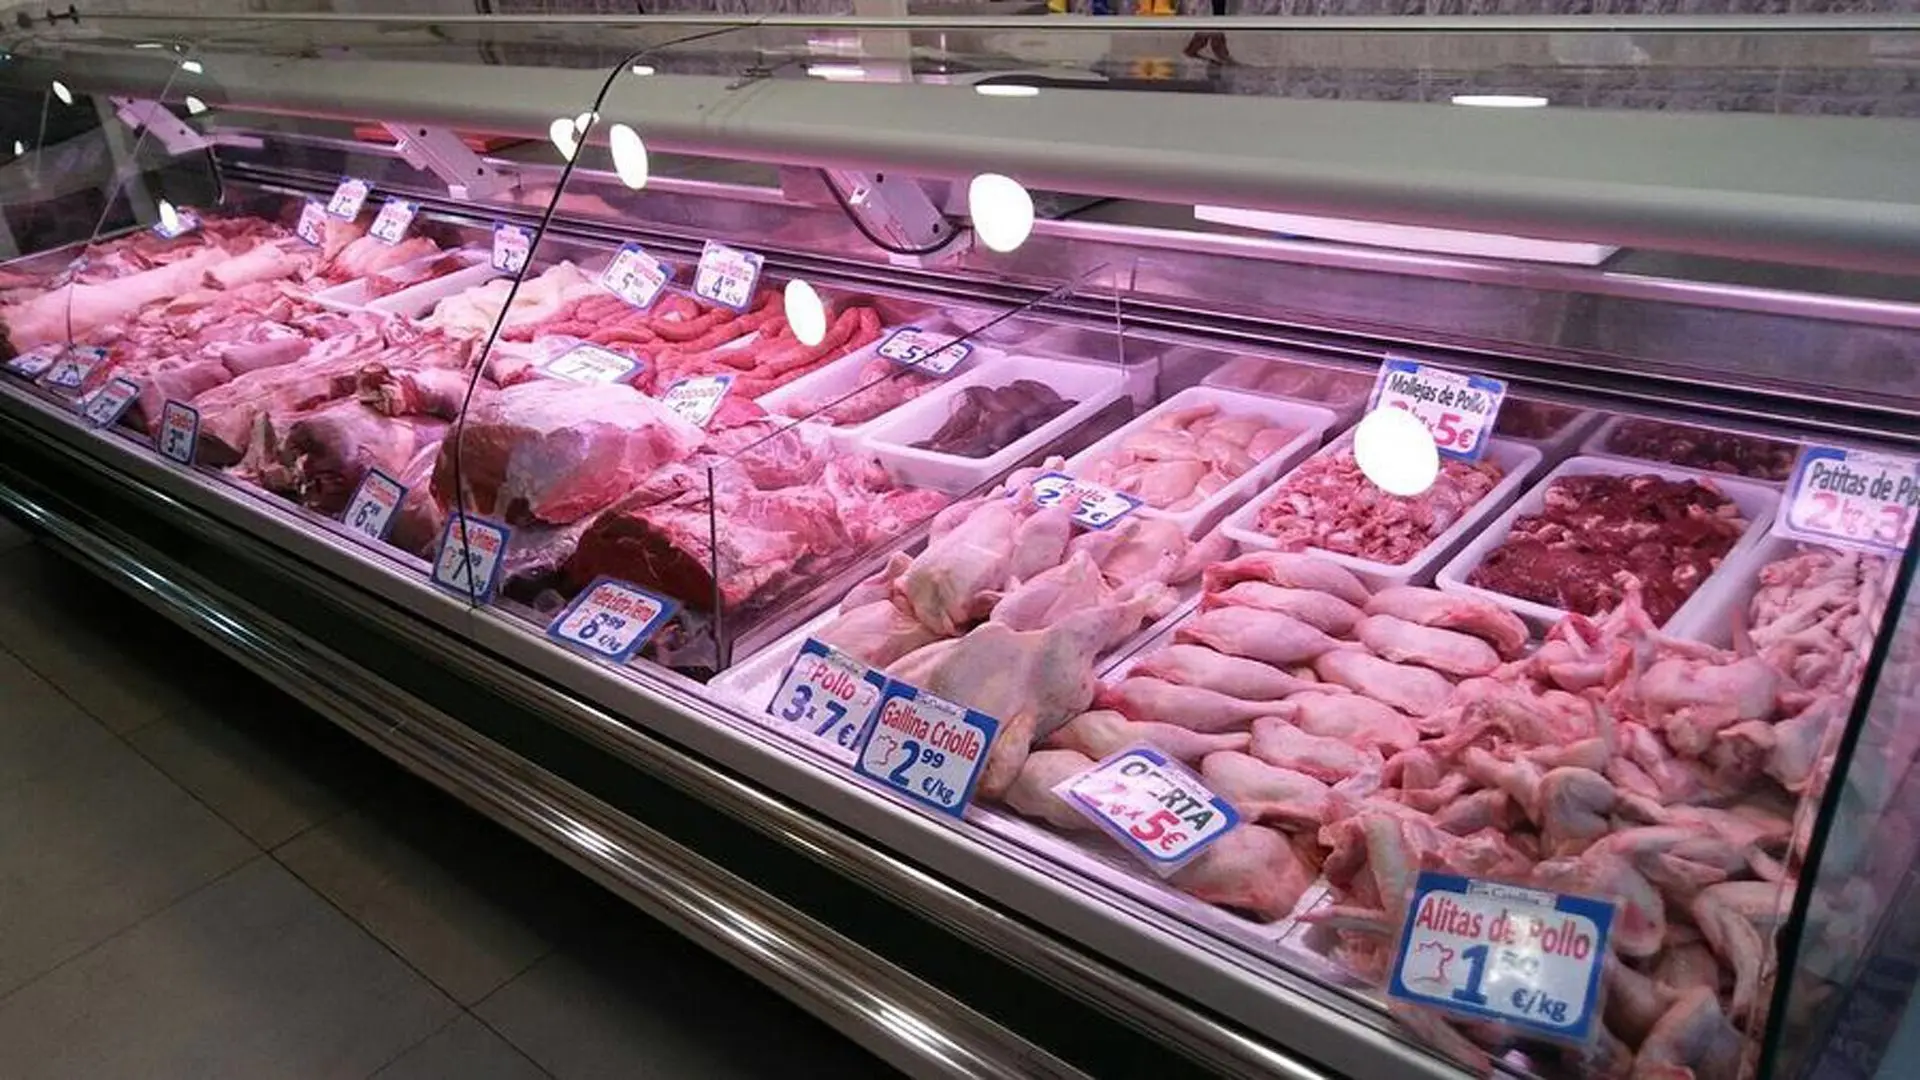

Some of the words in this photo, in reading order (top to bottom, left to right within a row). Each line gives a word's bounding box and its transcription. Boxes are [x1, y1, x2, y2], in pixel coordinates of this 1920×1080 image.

[711, 274, 724, 297] 4
[899, 345, 923, 360] 5
[1388, 373, 1438, 403] Mollejas
[1438, 385, 1454, 406] de
[1454, 389, 1486, 415] Pollo
[1808, 461, 1869, 497] Patitas
[1869, 470, 1894, 501] de
[355, 500, 373, 528] 6
[810, 663, 857, 701] Pollo
[881, 700, 930, 740] Gallina
[930, 720, 980, 762] Criolla
[888, 739, 921, 786] 2
[920, 748, 945, 769] 99
[921, 775, 955, 805] €/kg
[1119, 760, 1214, 832] ORTA
[1416, 896, 1485, 938] Alitas
[1451, 943, 1490, 1006] 1
[1510, 987, 1569, 1024] €/kg
